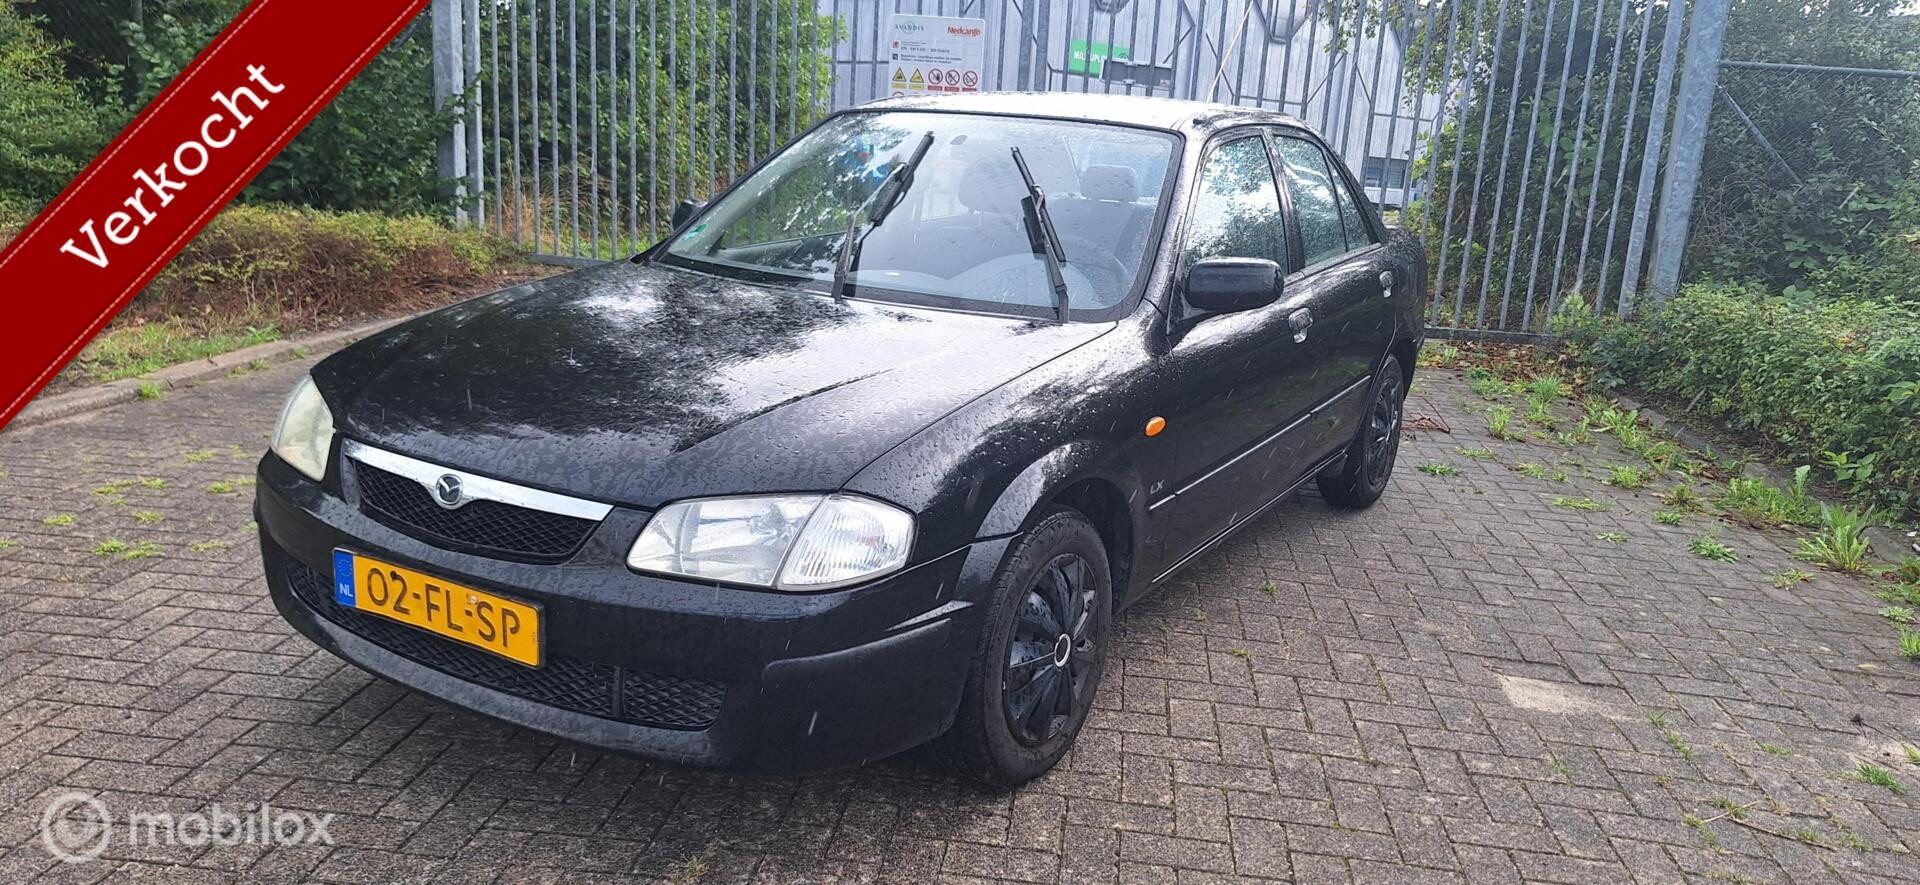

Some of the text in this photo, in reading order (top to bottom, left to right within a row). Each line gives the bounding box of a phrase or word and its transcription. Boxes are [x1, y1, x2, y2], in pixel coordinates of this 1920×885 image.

[946, 25, 982, 38] Nedcargo
[1150, 479, 1166, 495] LX
[339, 582, 354, 598] NL
[366, 566, 521, 649] 02-FL-SP
